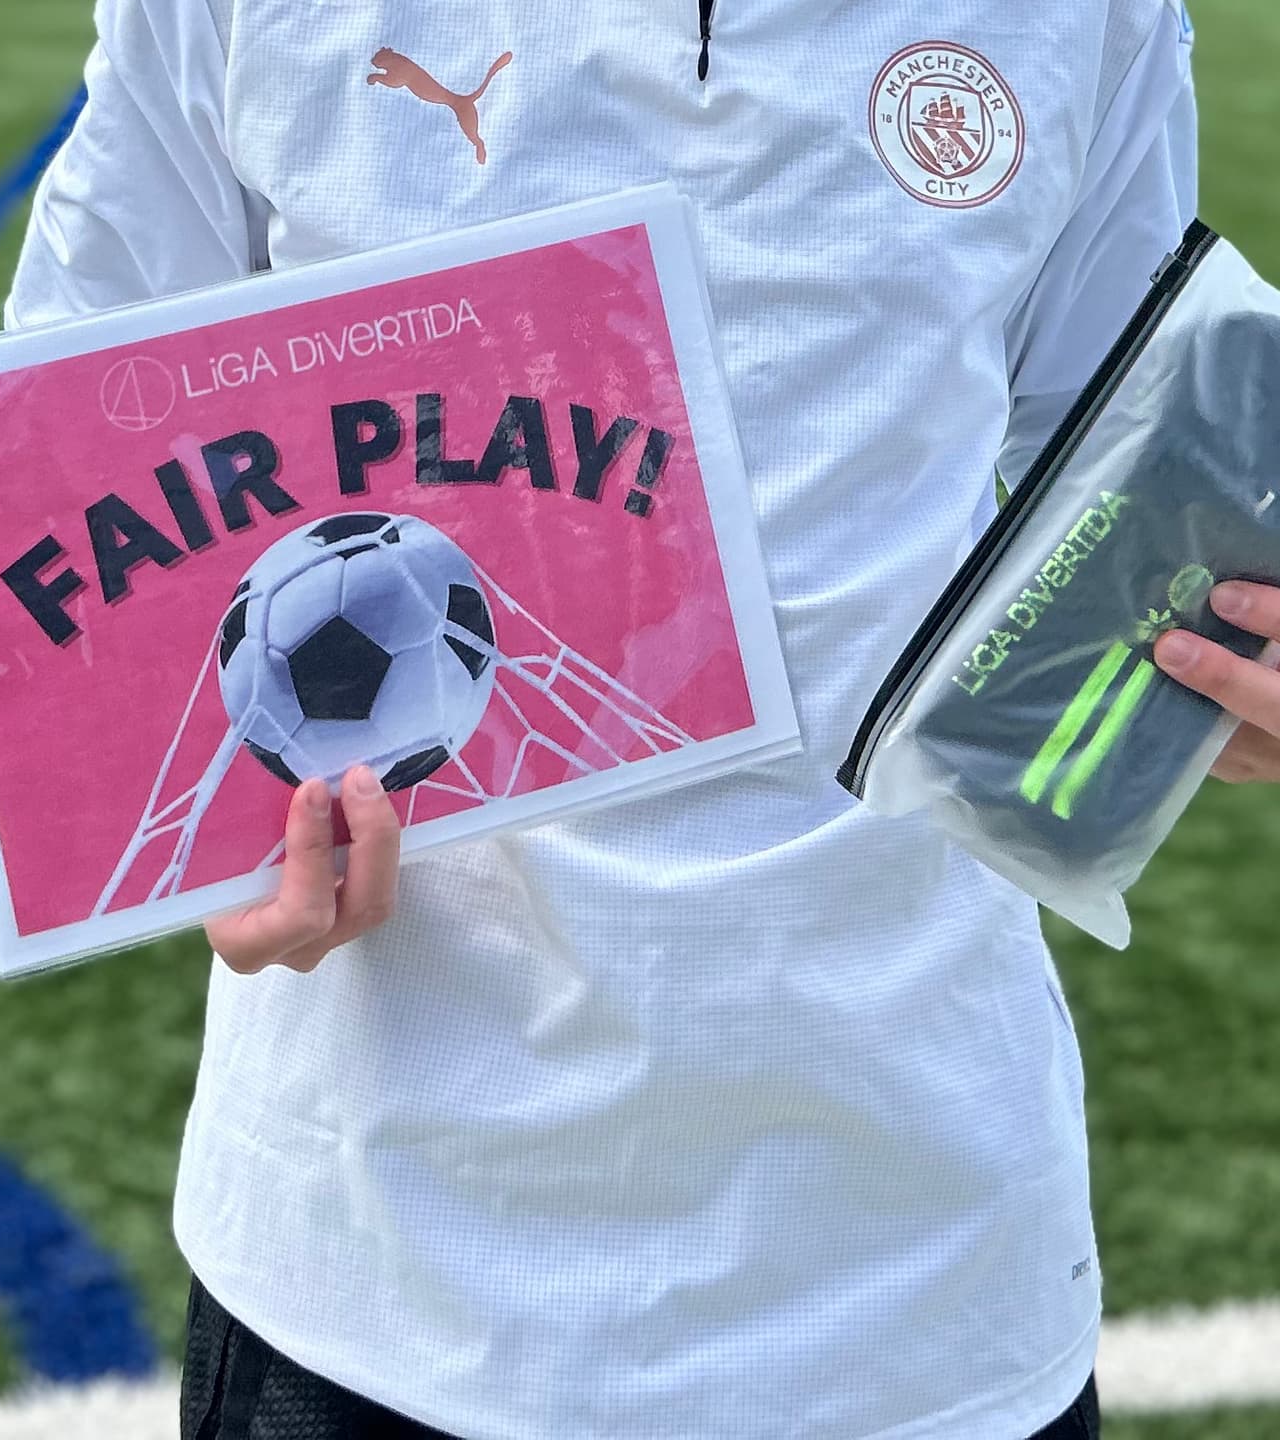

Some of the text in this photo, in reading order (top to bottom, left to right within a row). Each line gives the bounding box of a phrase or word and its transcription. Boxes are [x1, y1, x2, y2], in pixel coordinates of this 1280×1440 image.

[886, 55, 1005, 112] MANCHESTER
[881, 113, 893, 124] 18
[998, 128, 1013, 138] 94
[925, 179, 969, 196] CITY
[0, 391, 677, 648] FAIR PLAY!
